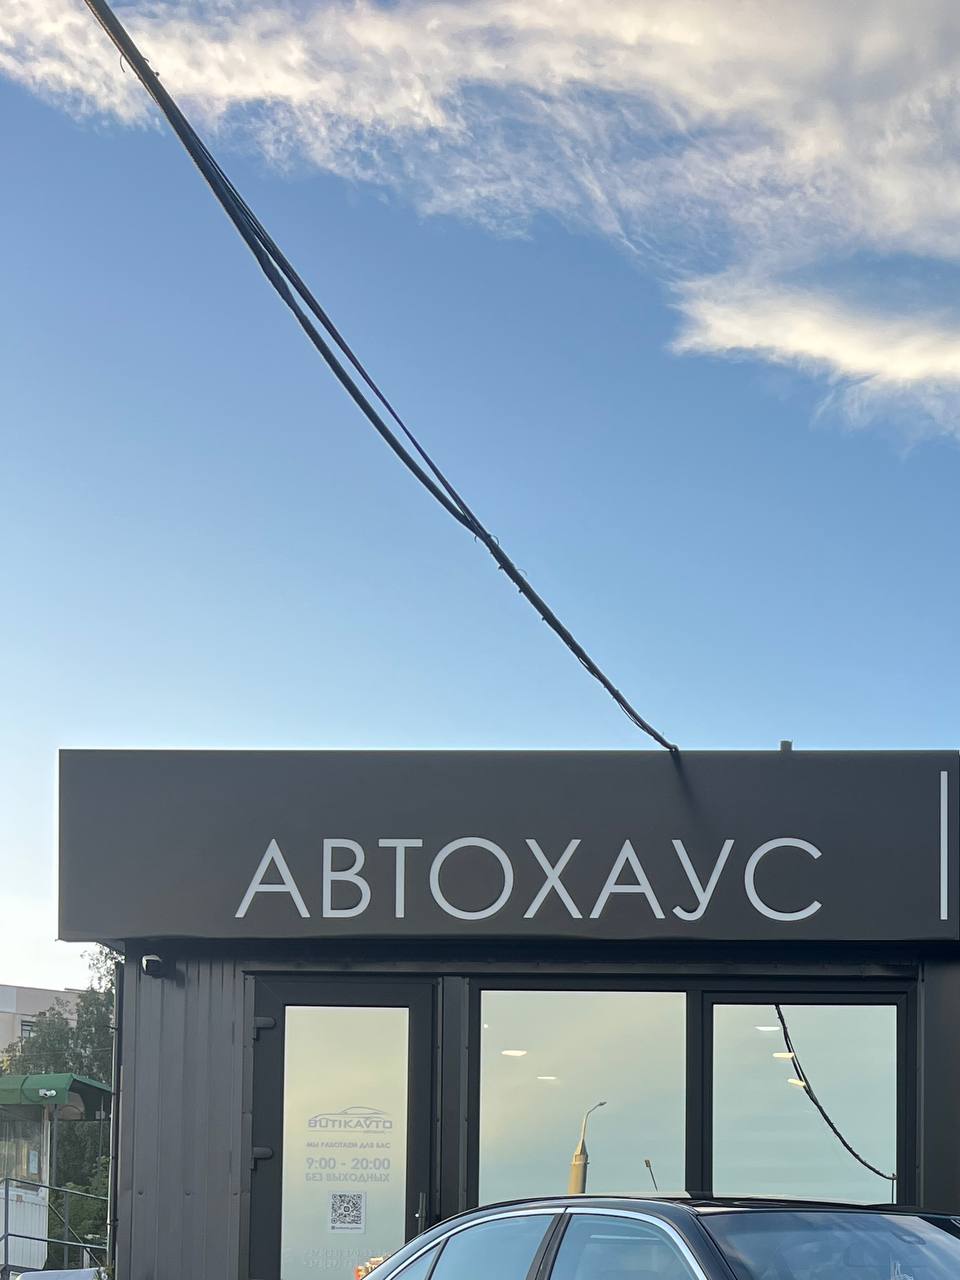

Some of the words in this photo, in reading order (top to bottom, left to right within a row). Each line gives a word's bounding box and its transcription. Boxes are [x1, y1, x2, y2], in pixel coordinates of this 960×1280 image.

[234, 836, 823, 922] АВТОХАУС
[307, 1118, 393, 1130] BUTIKAVTO
[305, 1157, 336, 1170] 9:00
[351, 1157, 391, 1170] 20:00
[305, 1172, 323, 1183] БЕЗ
[326, 1172, 391, 1183] ВЫХОДНЫХ
